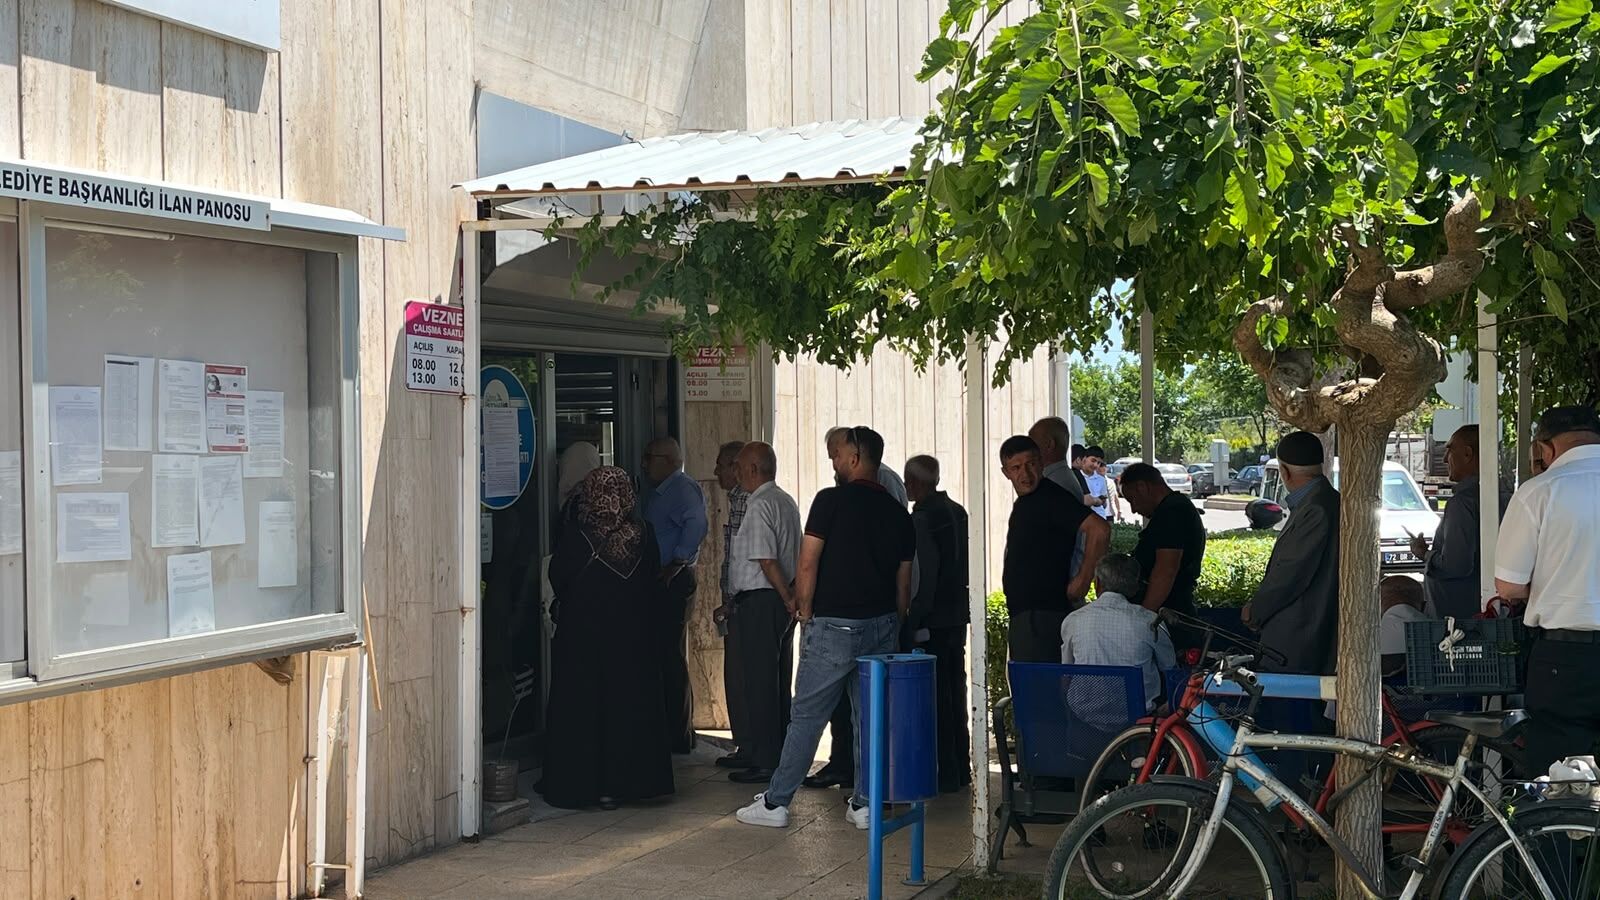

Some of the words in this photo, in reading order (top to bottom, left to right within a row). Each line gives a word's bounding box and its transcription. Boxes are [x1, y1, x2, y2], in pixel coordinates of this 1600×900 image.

[0, 168, 53, 195] EDİYE
[58, 177, 154, 209] BAŞKANLIĞI
[159, 188, 192, 214] İLAN
[196, 198, 251, 222] PANOSU
[421, 307, 463, 327] VEZNE
[413, 323, 442, 336] ÇALIŞMA
[443, 327, 463, 338] SAATL
[413, 341, 434, 354] AÇILIŞ
[446, 344, 463, 355] KAPA
[412, 358, 436, 371] 08.00
[412, 372, 436, 385] 13.00
